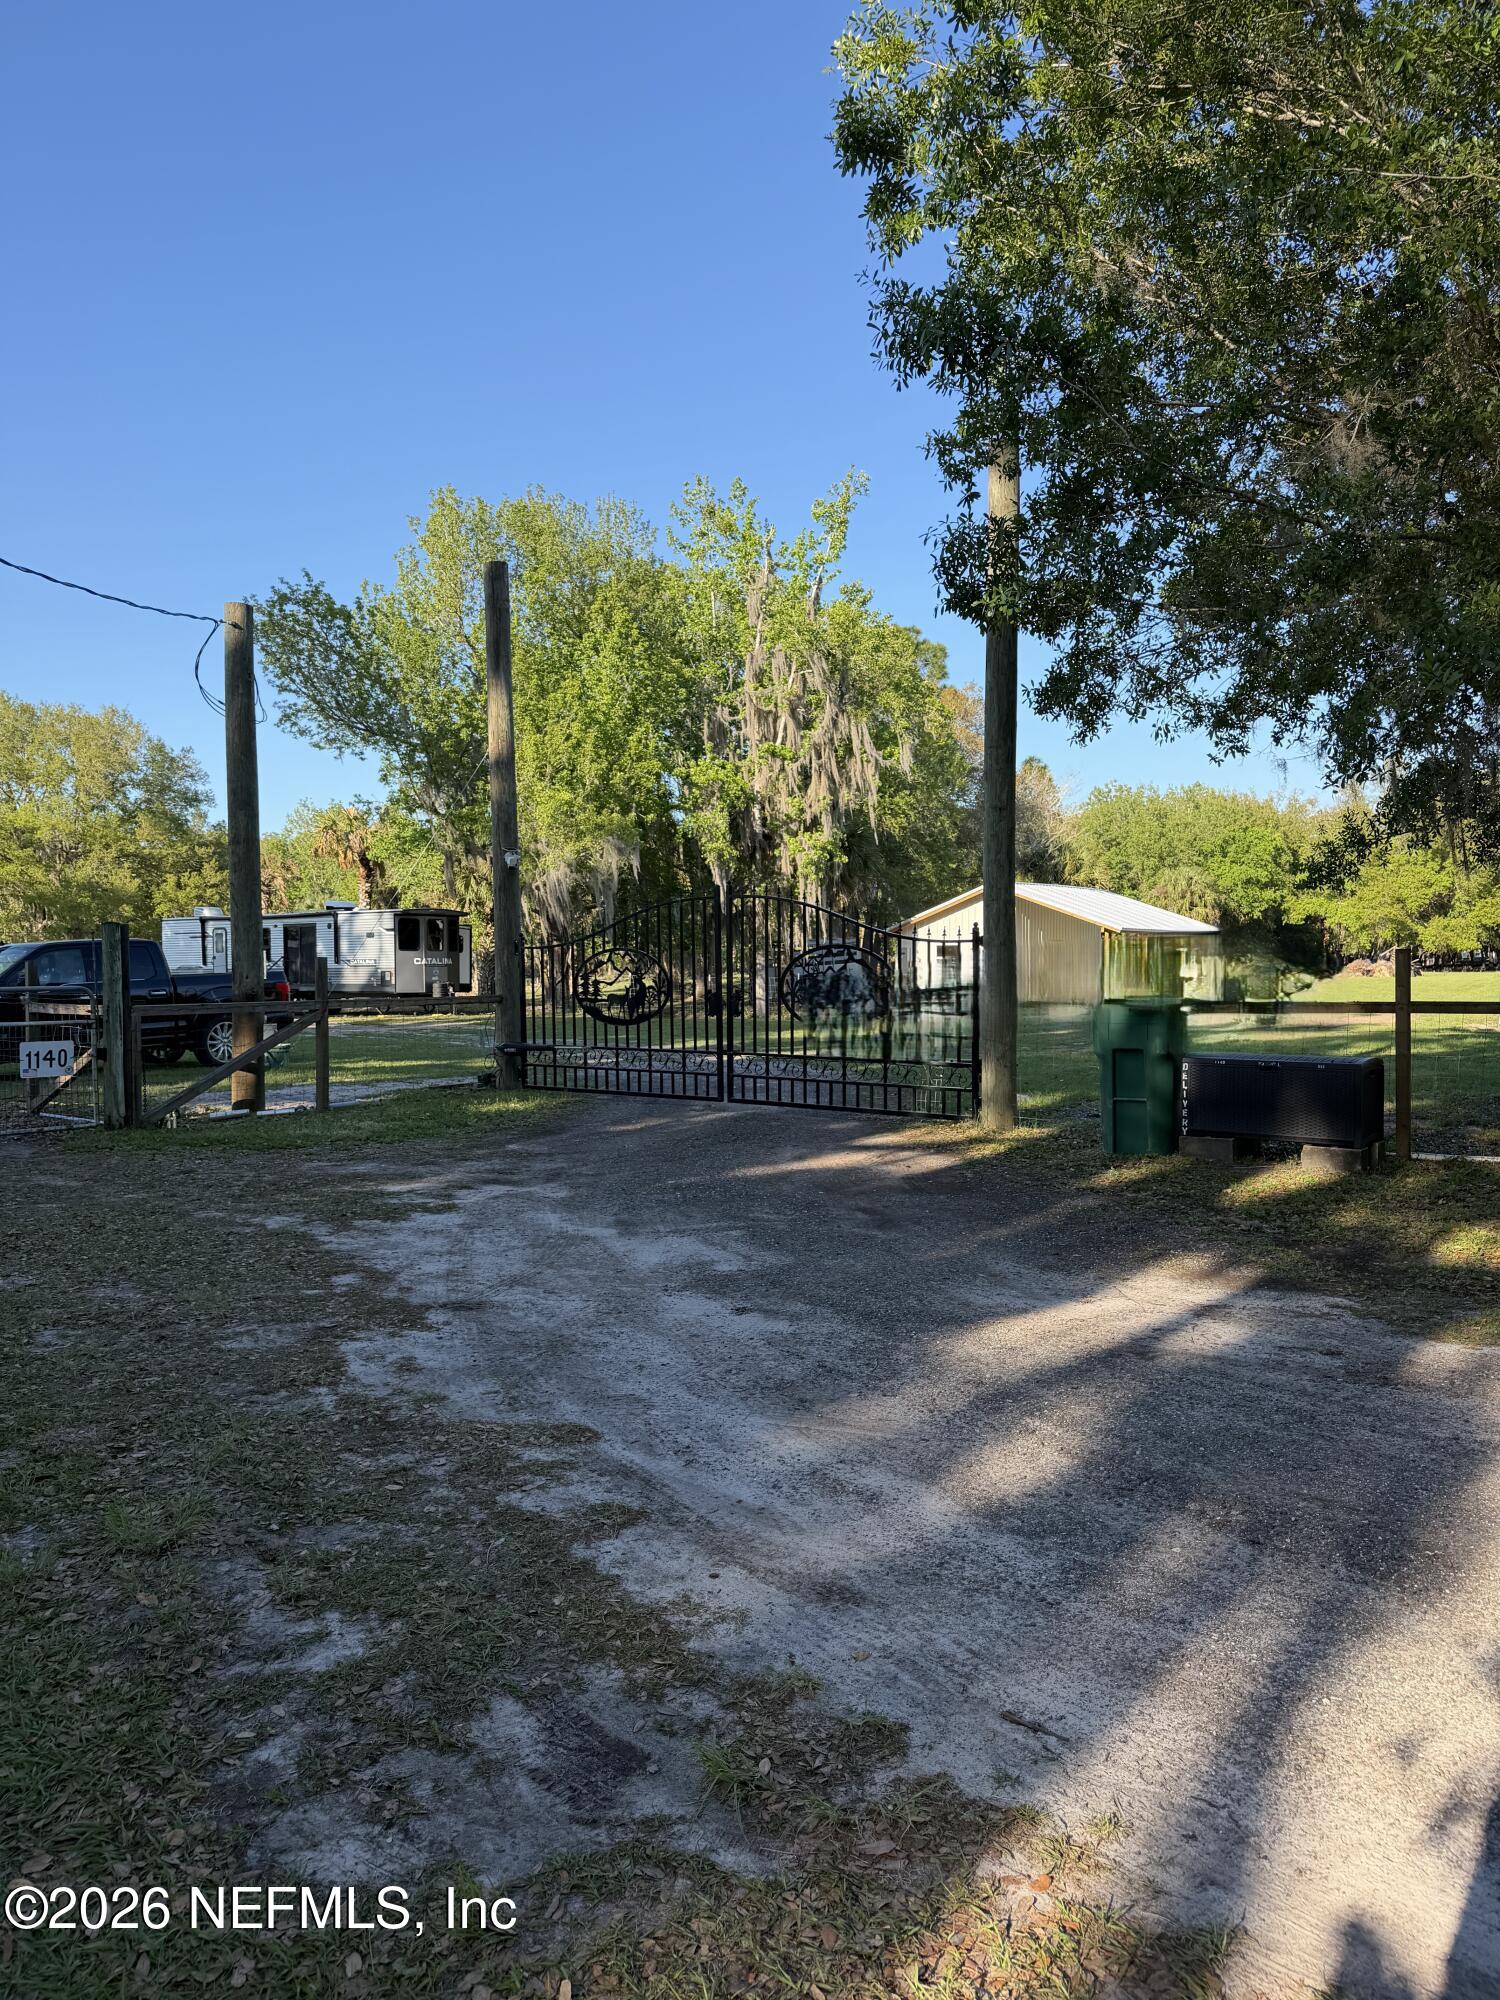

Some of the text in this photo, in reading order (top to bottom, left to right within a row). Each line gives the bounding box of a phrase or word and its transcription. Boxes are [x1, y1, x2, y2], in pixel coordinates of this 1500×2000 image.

[413, 957, 453, 965] CATALINA
[25, 1048, 68, 1069] 1140
[1181, 1062, 1189, 1136] DELIVERY
